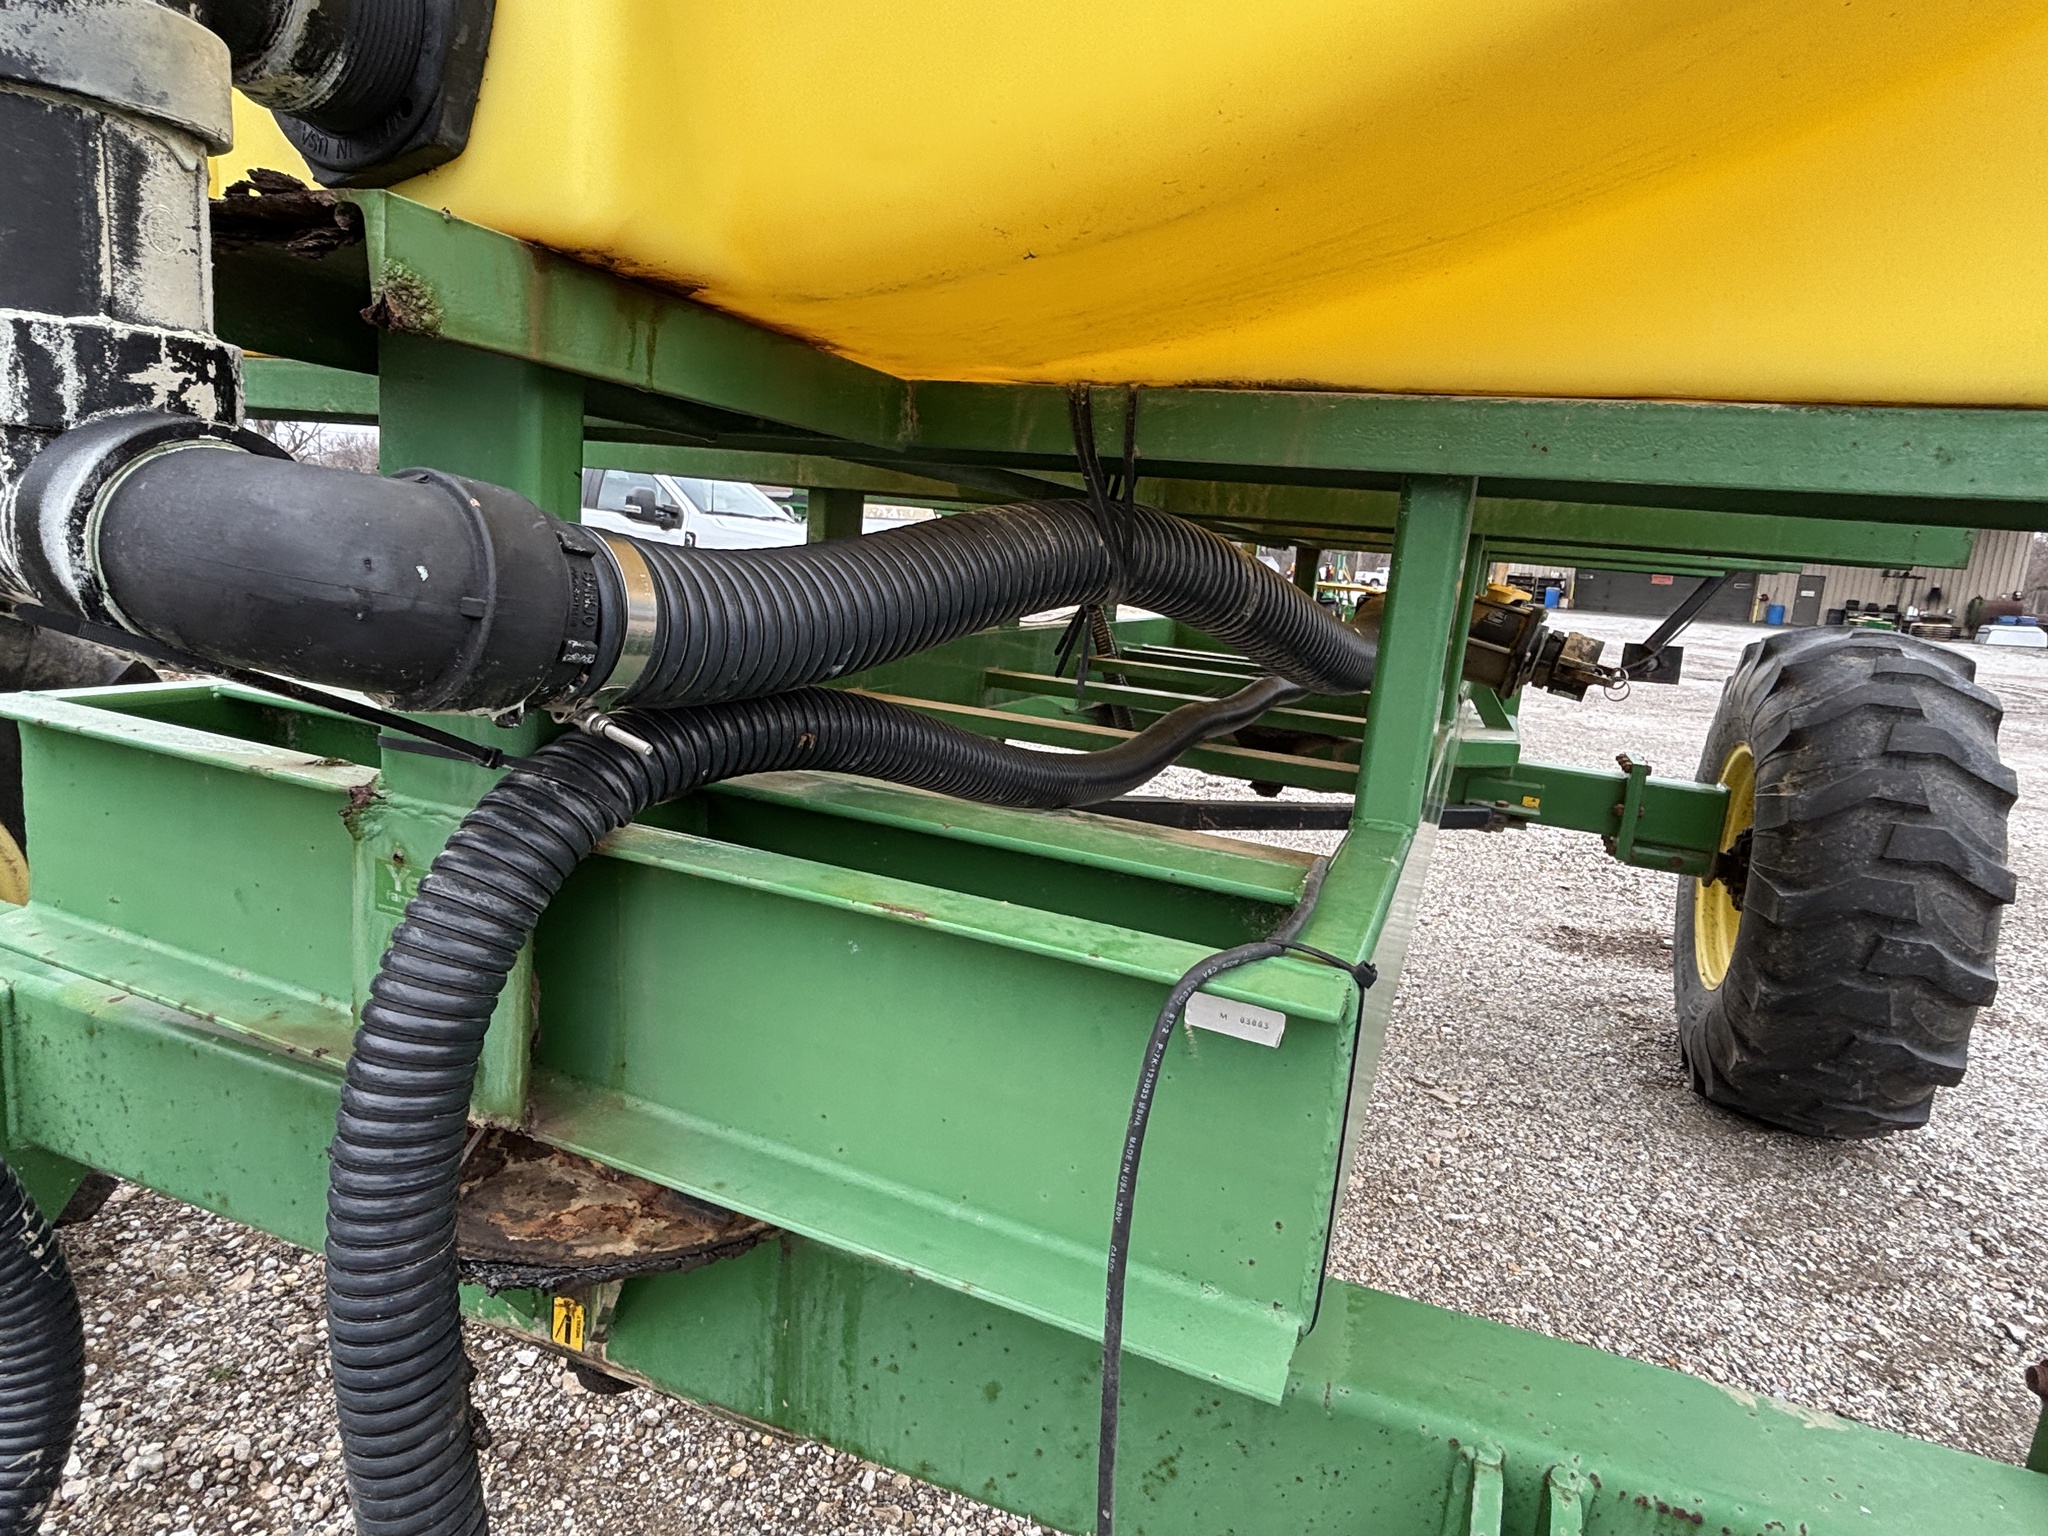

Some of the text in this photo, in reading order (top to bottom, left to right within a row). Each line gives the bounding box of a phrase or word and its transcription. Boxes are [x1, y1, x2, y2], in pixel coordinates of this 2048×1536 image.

[301, 123, 353, 160] IN USA
[1124, 1136, 1137, 1161] MADE
[1122, 1163, 1131, 1174] IN
[1119, 1175, 1129, 1193] USA
